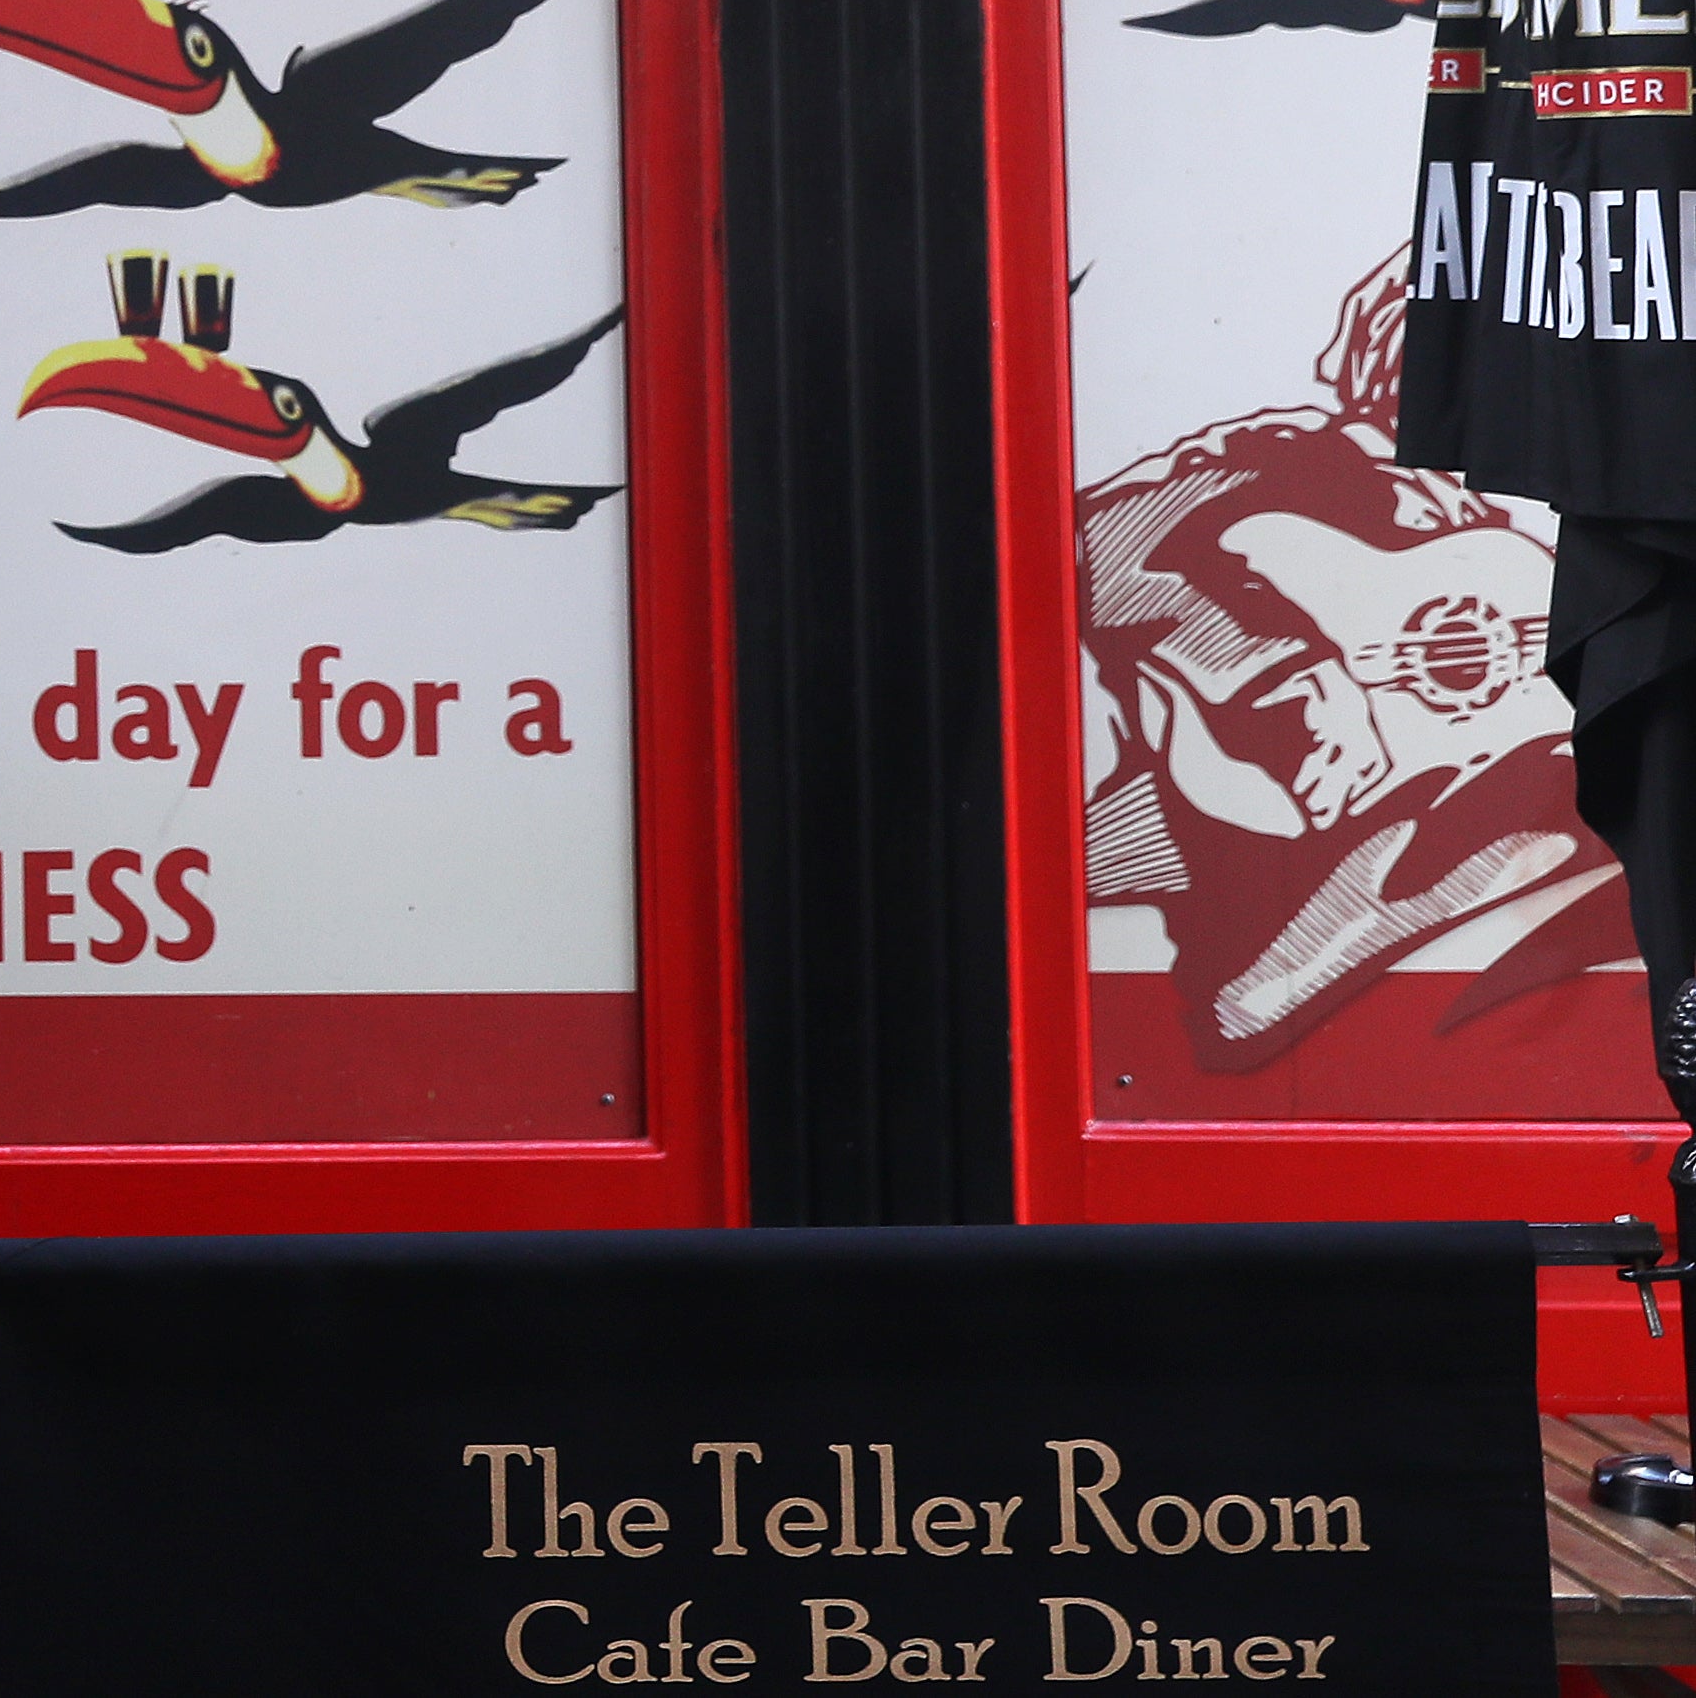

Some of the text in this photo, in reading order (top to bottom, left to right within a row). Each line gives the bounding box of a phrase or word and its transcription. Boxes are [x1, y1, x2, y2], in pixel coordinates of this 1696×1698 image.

[33, 649, 244, 789] day
[292, 645, 460, 759] for
[506, 678, 573, 757] a
[462, 1438, 1371, 1558] The Teller Room
[504, 1596, 1336, 1685] Cafe Bar Diner
